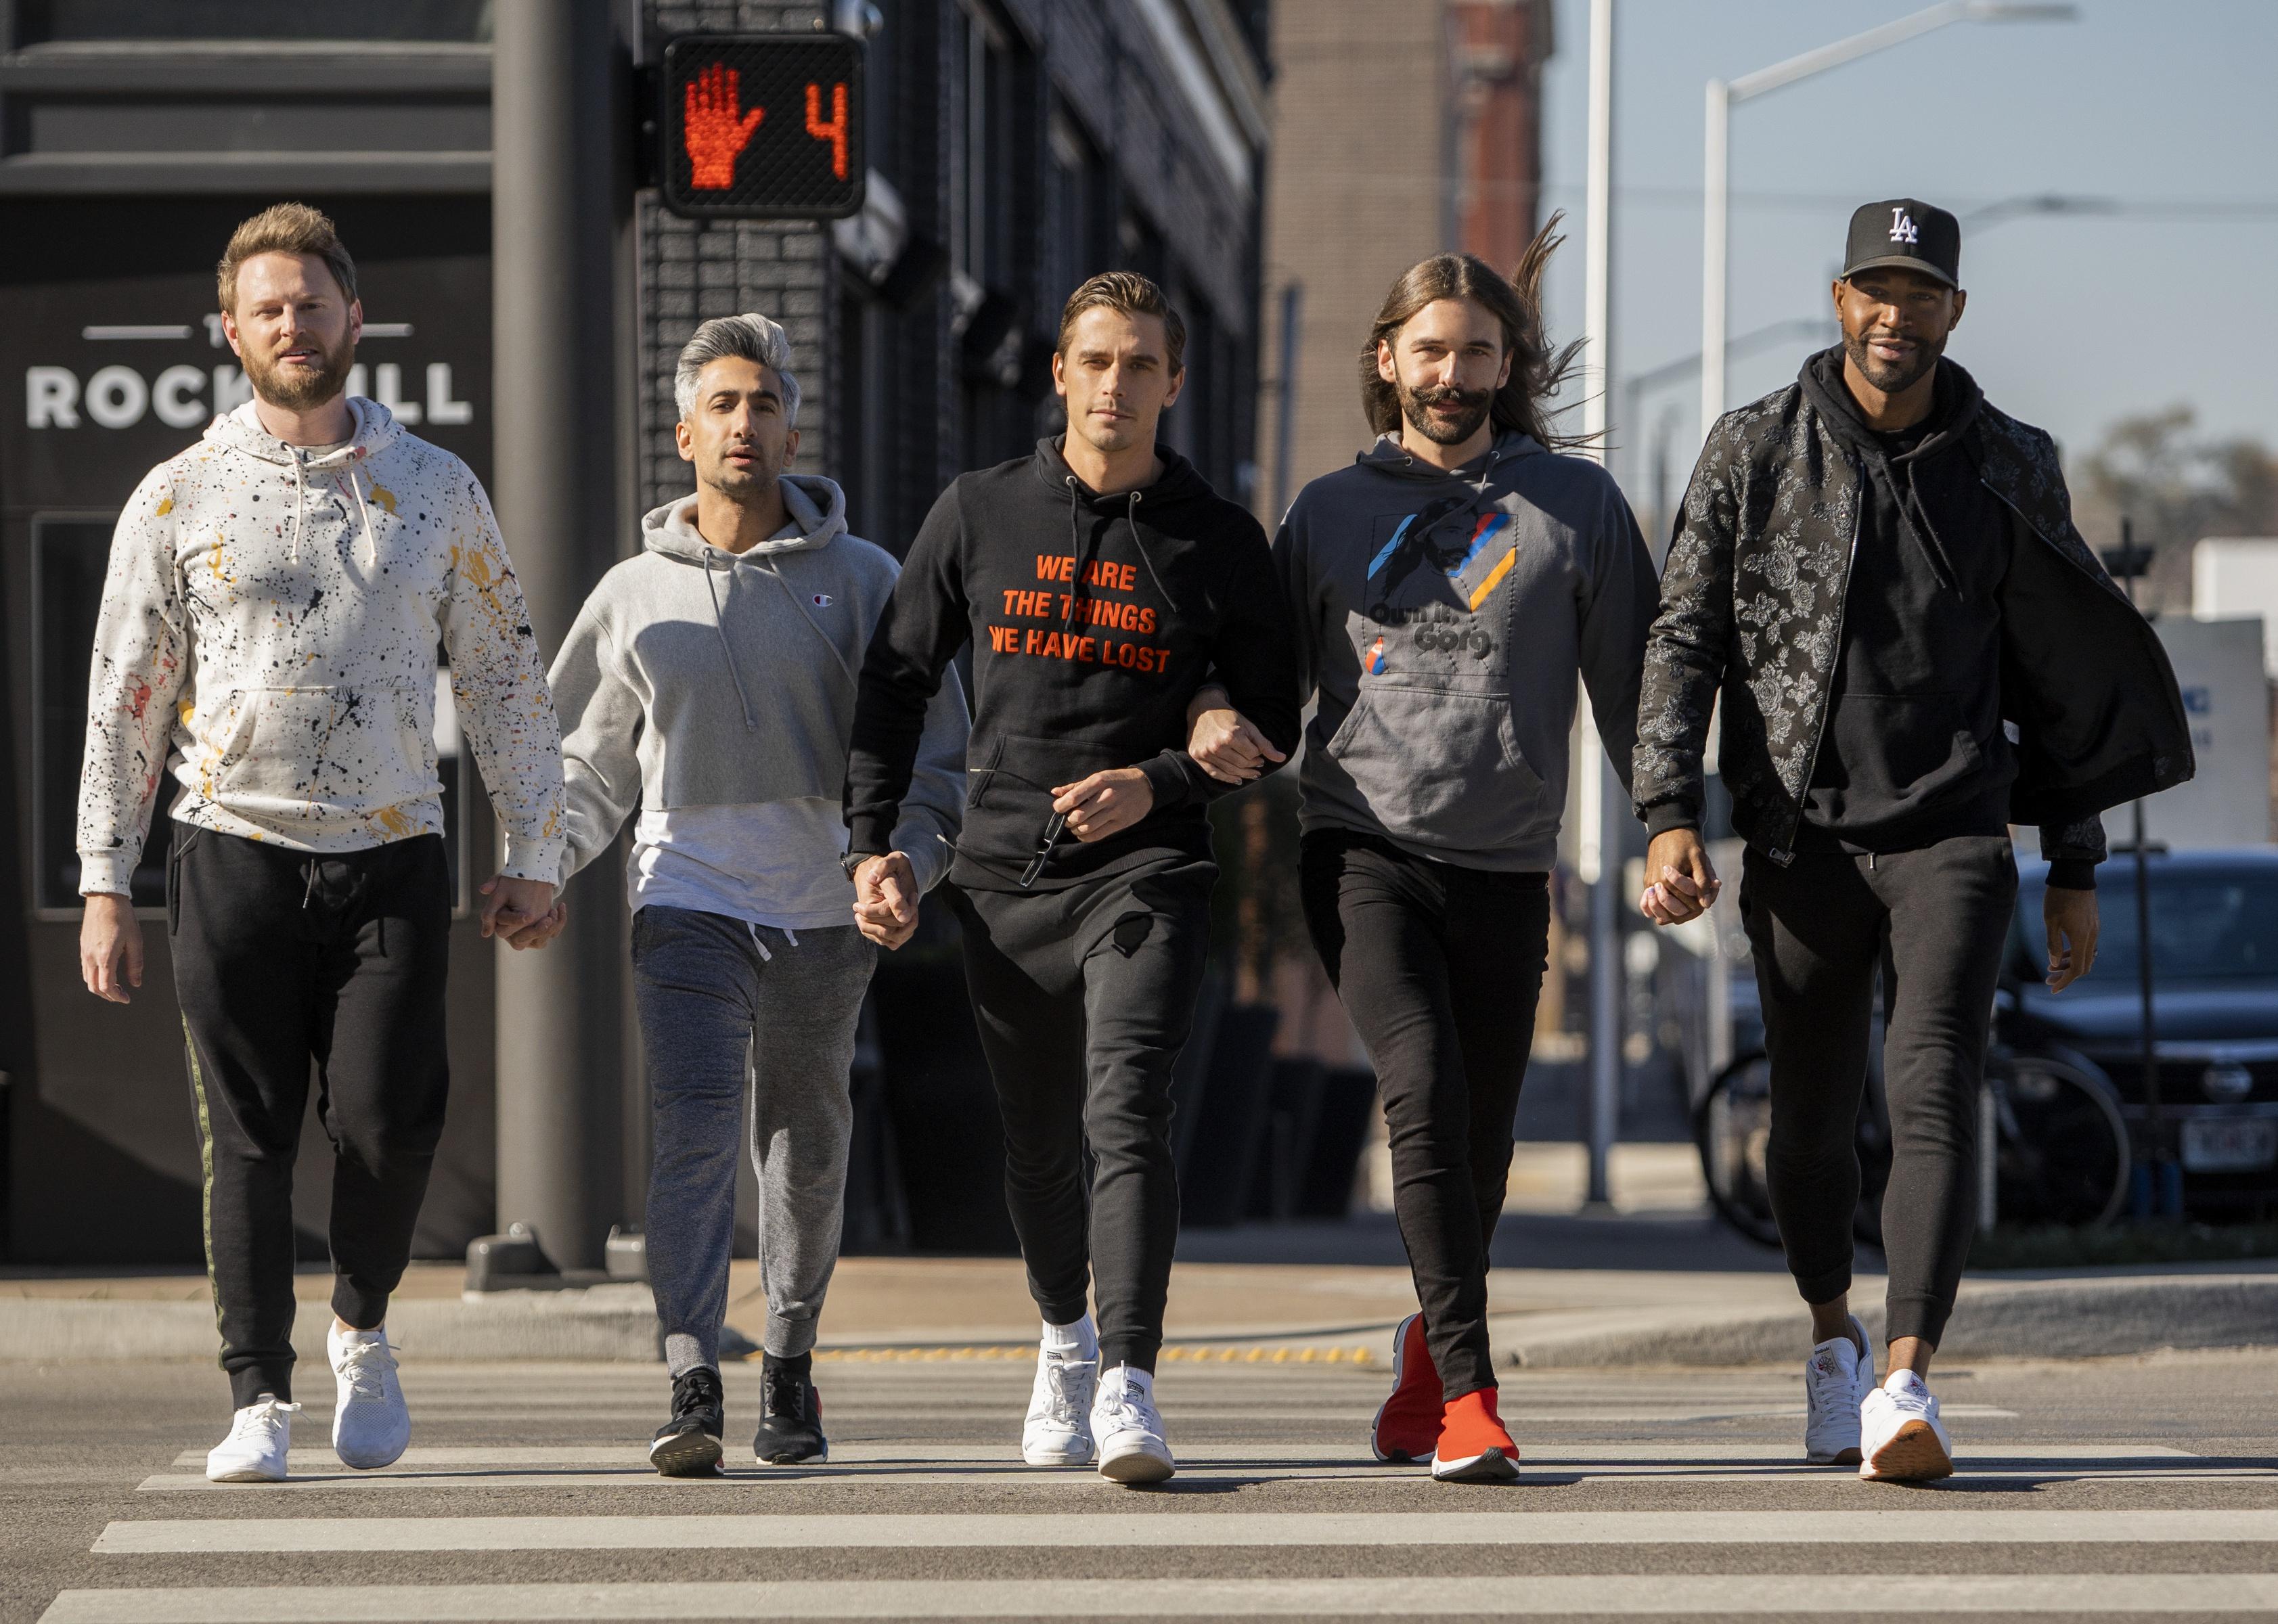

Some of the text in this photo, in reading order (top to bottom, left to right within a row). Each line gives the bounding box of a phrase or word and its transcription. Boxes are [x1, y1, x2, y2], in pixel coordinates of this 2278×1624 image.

[805, 82, 848, 183] 4
[1889, 207, 1918, 244] LA
[26, 362, 474, 430] ROCKILL
[1036, 555, 1137, 591] WE ARE
[1003, 590, 1157, 634] THE THINGS
[1369, 602, 1427, 624] Own
[988, 625, 1170, 673] WE HAVE LOST
[1414, 622, 1500, 660] Gorg.
